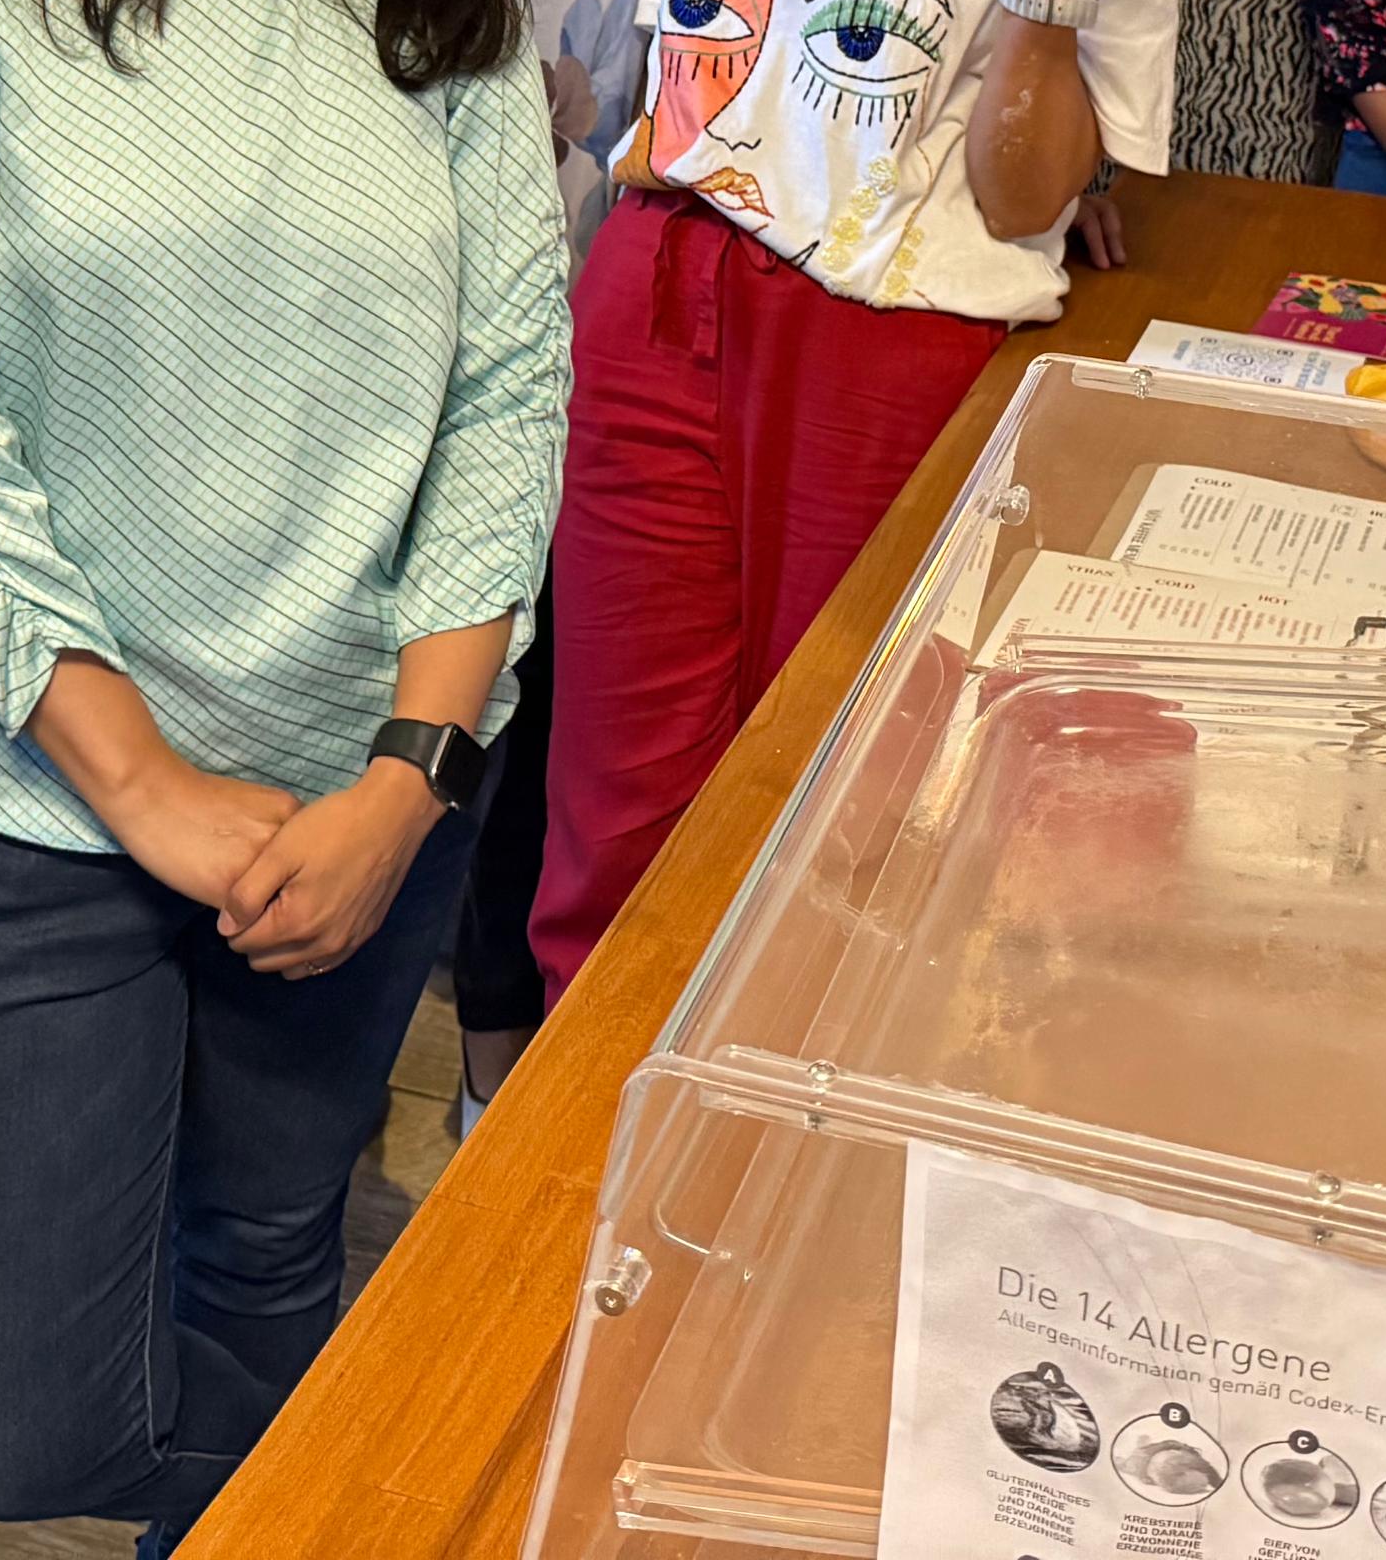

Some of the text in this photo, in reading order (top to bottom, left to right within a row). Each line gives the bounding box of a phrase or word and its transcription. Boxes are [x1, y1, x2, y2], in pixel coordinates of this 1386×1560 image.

[1194, 477, 1233, 488] COLD
[1155, 578, 1196, 590] COLD
[1258, 594, 1293, 606] HOT
[997, 1265, 1331, 1382] Die 14 Allergene
[998, 1308, 1202, 1383] Allergeninformation
[1209, 1374, 1281, 1401] gemäß
[1043, 1369, 1057, 1384] A
[1169, 1407, 1181, 1422] B
[1296, 1435, 1310, 1449] C
[986, 1469, 1091, 1507] GLUTENHALTIGES
[1009, 1486, 1067, 1511] GETREIDE
[998, 1494, 1075, 1525] UND DARAUS
[997, 1504, 1073, 1535] GEWONNENE
[1124, 1514, 1202, 1530] KREBSTIERE
[994, 1513, 1075, 1546] ERZEUGNISSE
[1121, 1523, 1203, 1540] UND DARAUS
[1119, 1533, 1202, 1549] GEWONNENE
[1263, 1538, 1320, 1557] EIER VON
[1116, 1542, 1203, 1560] ERZEUGNISSE
